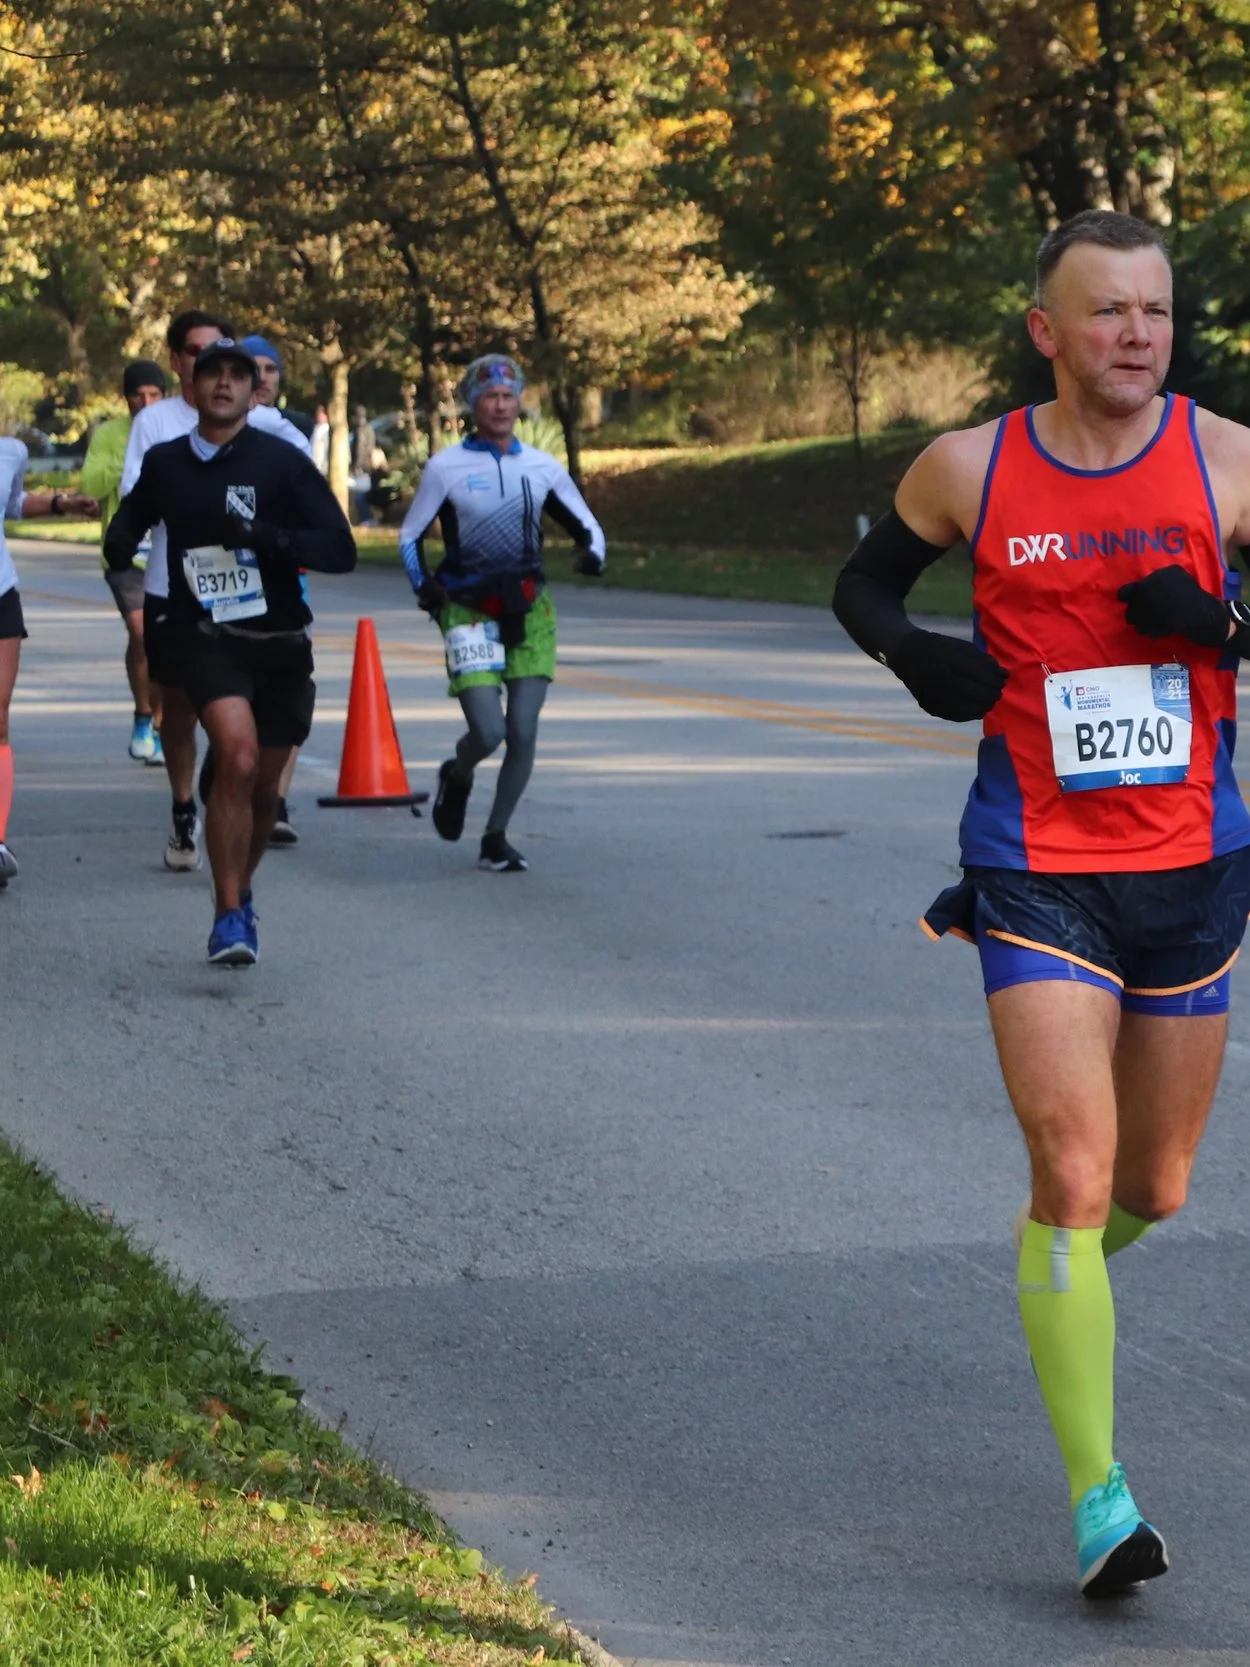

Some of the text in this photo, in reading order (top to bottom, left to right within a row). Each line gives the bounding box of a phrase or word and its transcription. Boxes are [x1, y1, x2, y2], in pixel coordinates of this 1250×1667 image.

[196, 568, 249, 594] B3719
[1167, 678, 1182, 690] 20
[1168, 689, 1182, 700] 21
[1077, 702, 1112, 711] MARATHON
[1075, 715, 1173, 762] B2760
